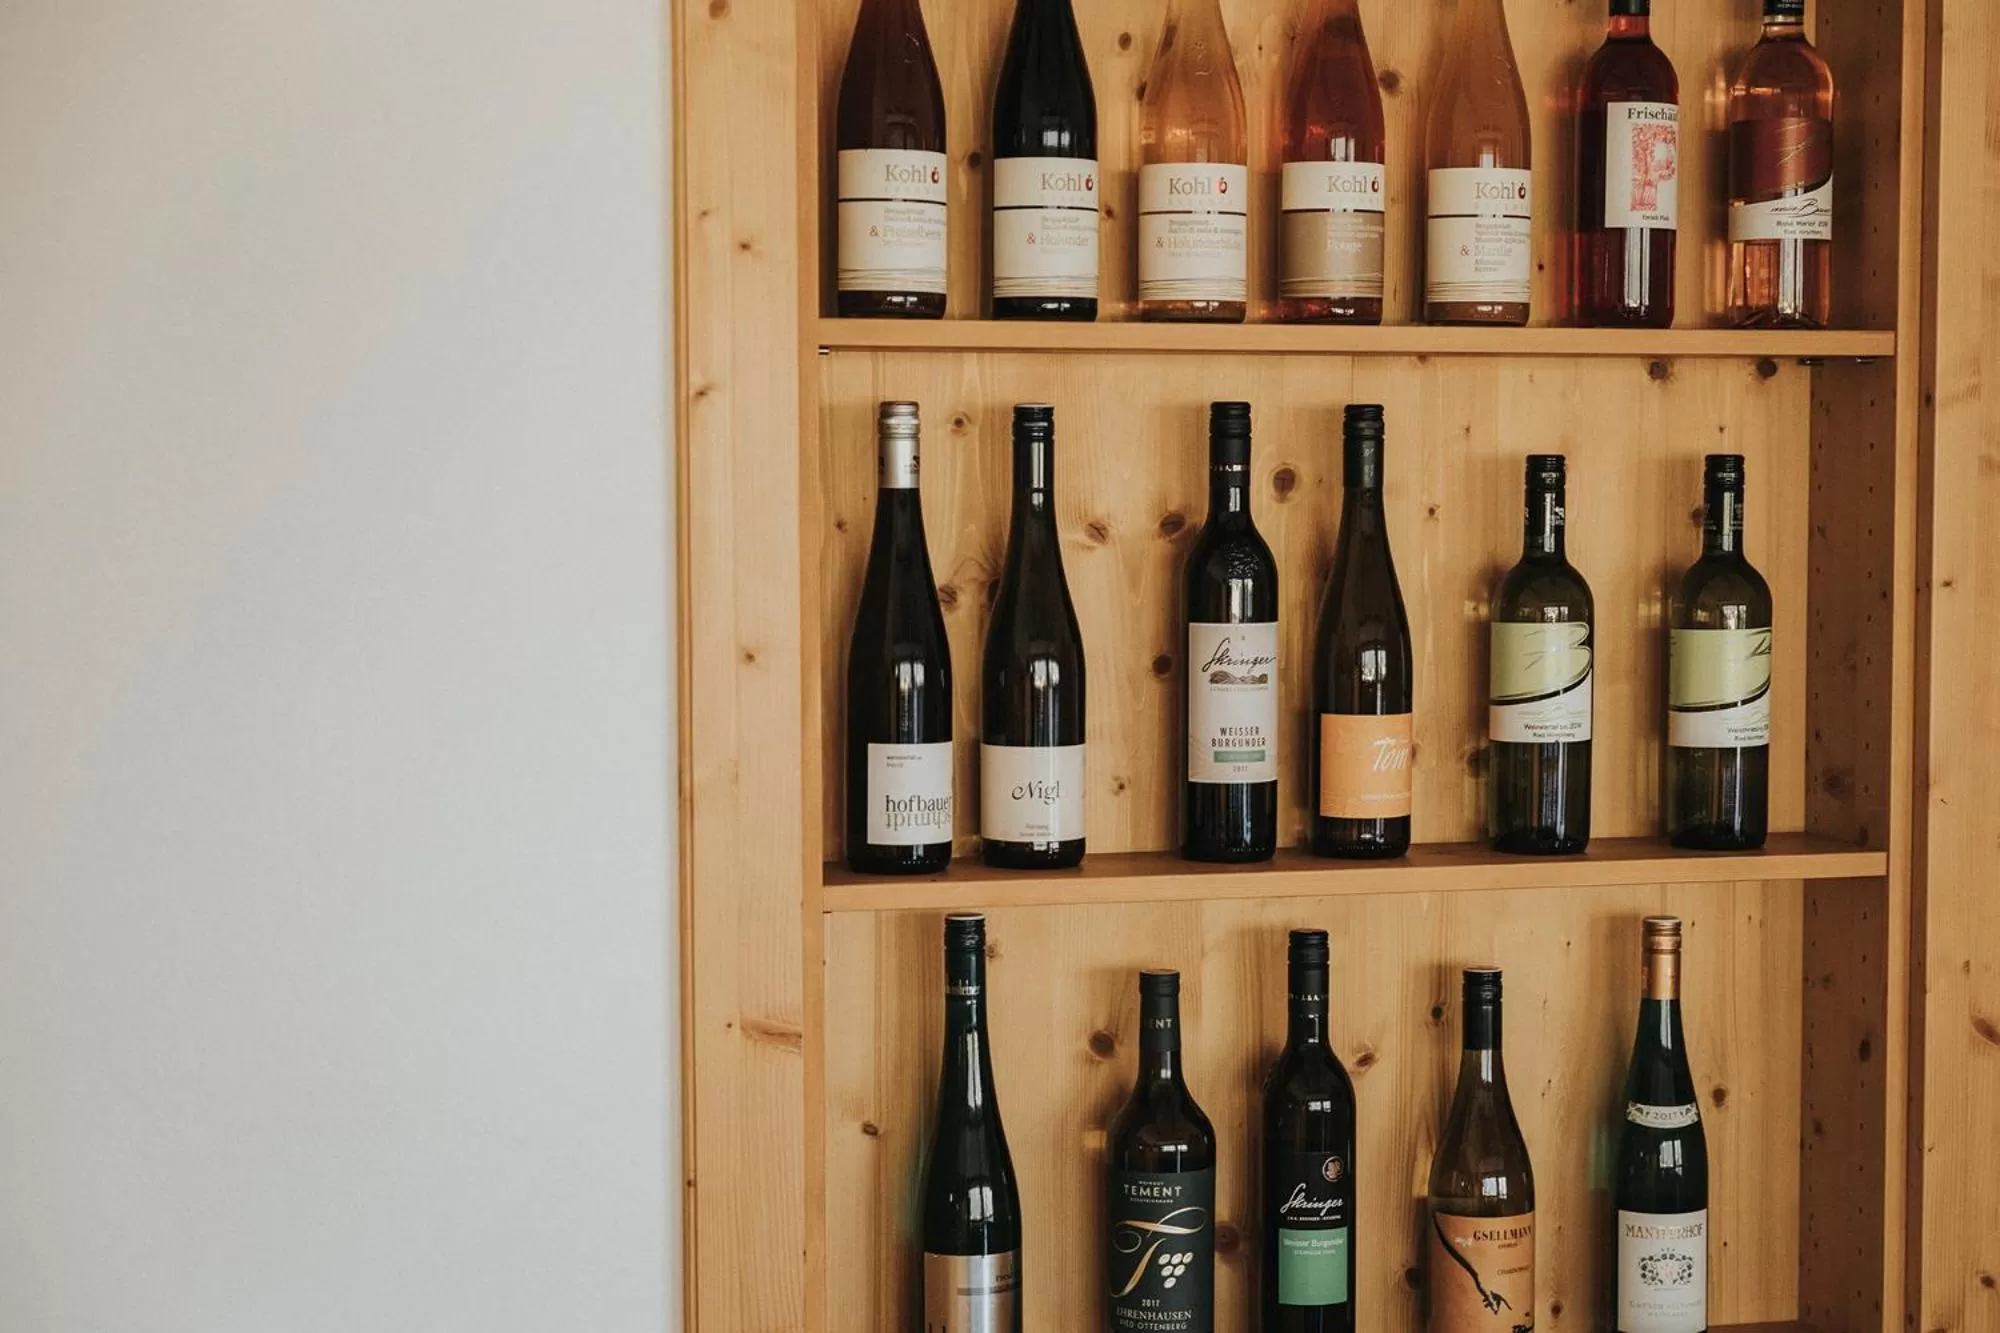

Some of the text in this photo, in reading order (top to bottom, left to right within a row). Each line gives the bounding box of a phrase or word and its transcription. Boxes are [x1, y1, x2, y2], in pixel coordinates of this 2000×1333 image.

[884, 163, 927, 184] Kohl
[1040, 172, 1081, 192] Kohl
[1168, 176, 1212, 195] Kohl
[1326, 175, 1367, 194] Kohl
[1475, 181, 1515, 200] Kohl
[869, 225, 879, 237] &
[1026, 231, 1036, 245] &
[1460, 244, 1470, 257] &
[1220, 726, 1259, 737] WEISSER
[1211, 736, 1266, 748] BURGUNDER
[1011, 780, 1060, 806] Nigl
[1123, 1183, 1182, 1198] TEMENT
